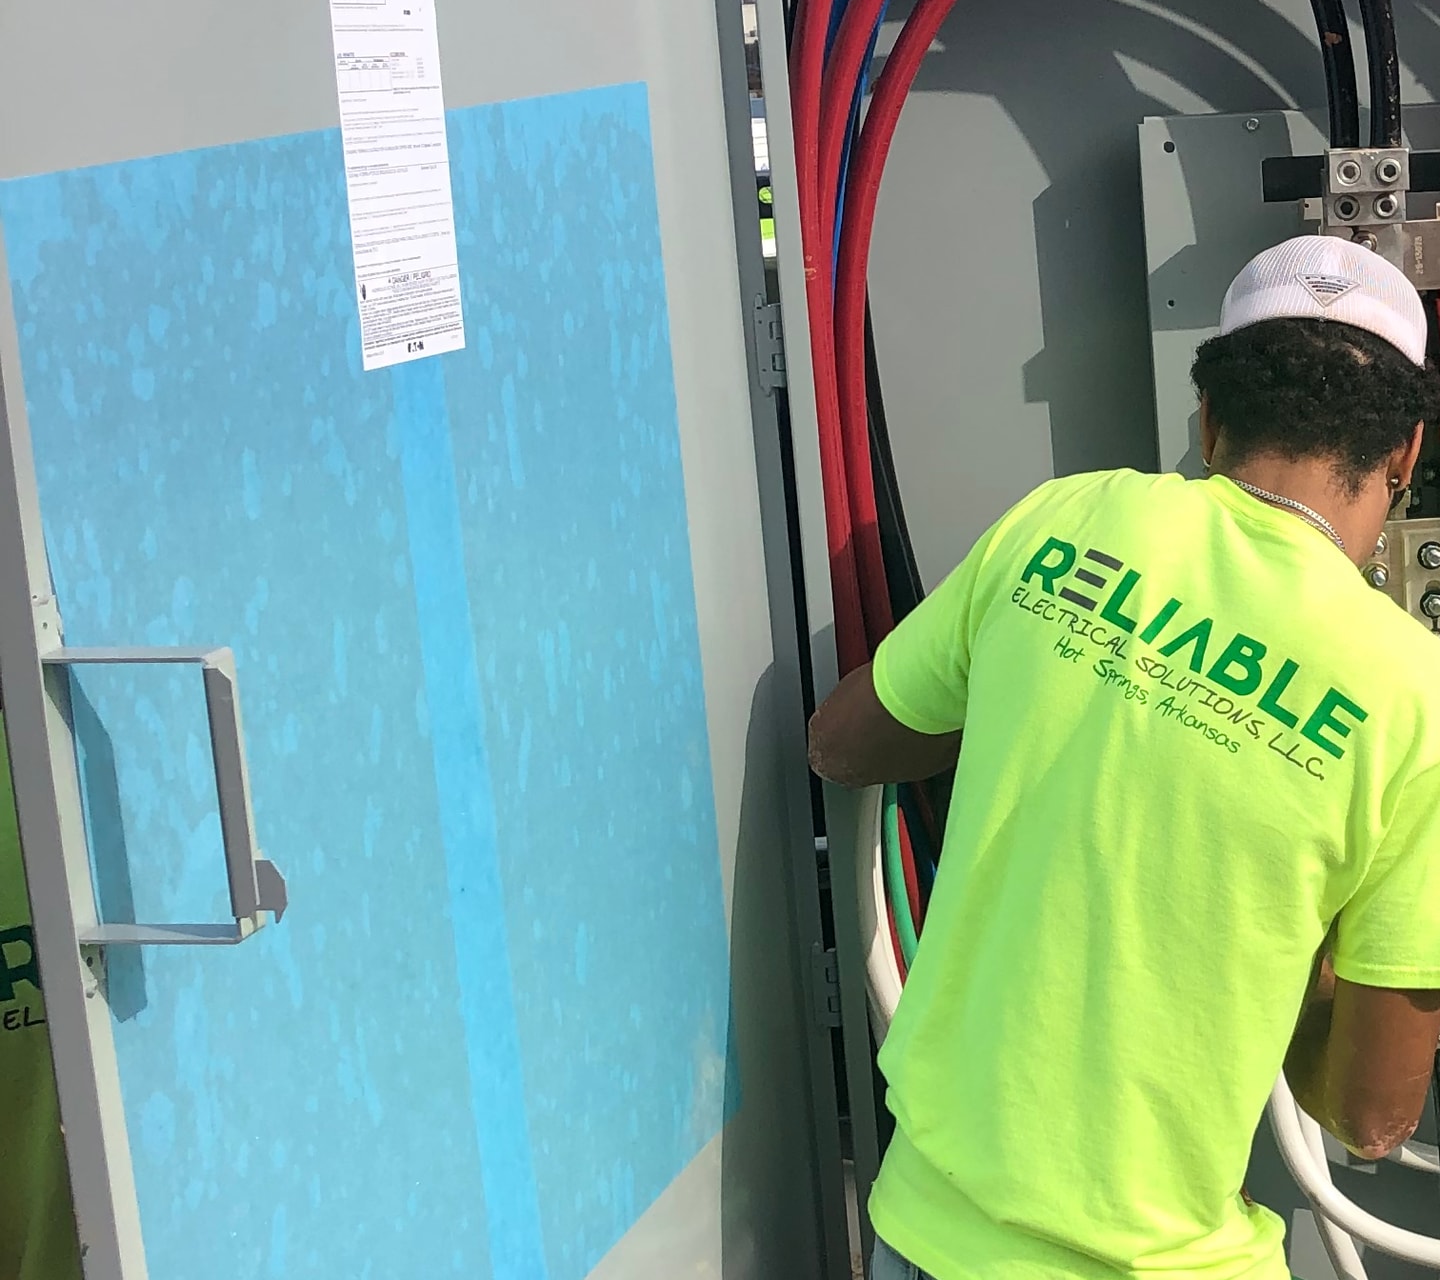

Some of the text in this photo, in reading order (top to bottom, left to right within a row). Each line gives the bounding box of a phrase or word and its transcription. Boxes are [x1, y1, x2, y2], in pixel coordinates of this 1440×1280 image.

[1011, 586, 1127, 660] ELECTRICAL
[1135, 656, 1266, 740] SOLUTIONS,
[1020, 536, 1369, 760] RELIABLE
[1053, 635, 1242, 754] Hot Springs, Arkansas
